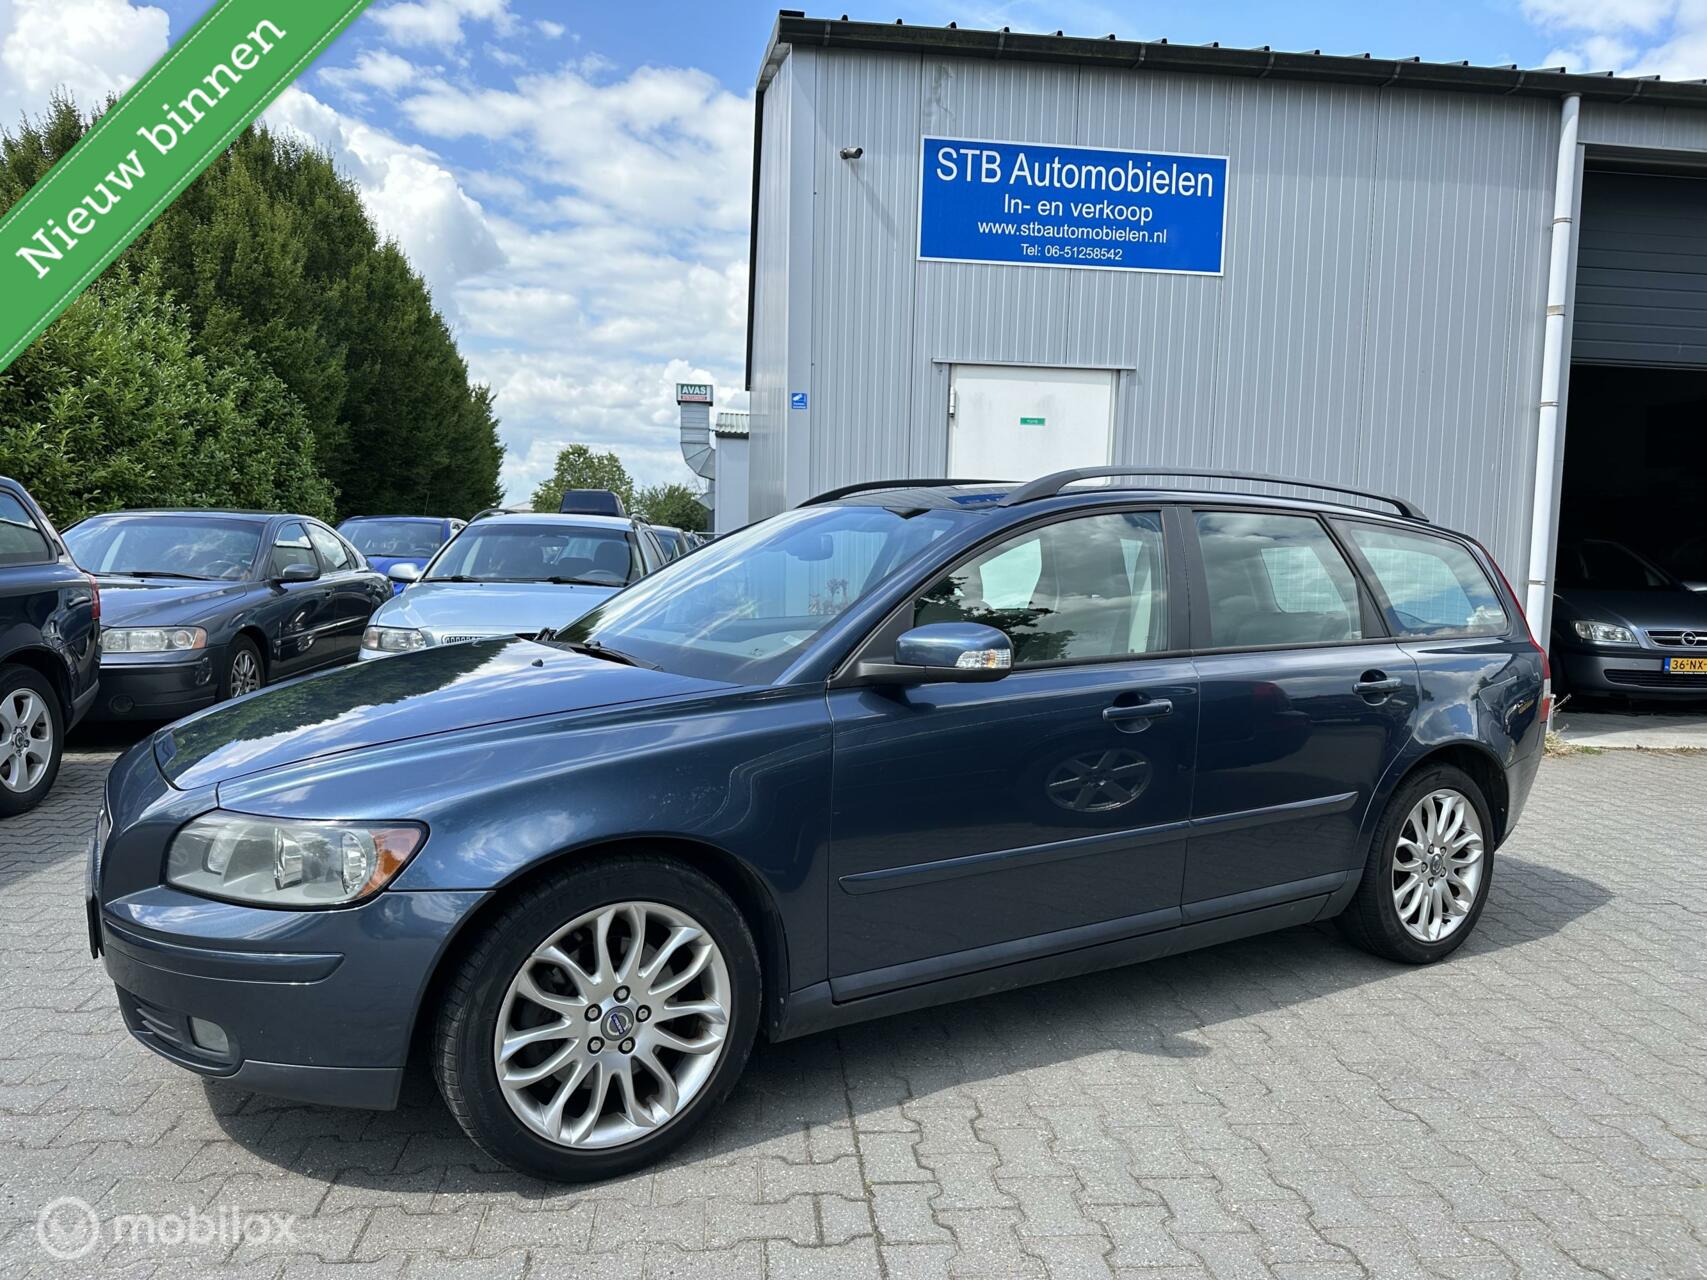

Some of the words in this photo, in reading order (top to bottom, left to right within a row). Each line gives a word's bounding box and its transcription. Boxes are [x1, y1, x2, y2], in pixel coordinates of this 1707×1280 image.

[936, 147, 1001, 183] STB
[1009, 153, 1213, 197] Automobielen
[1004, 194, 1031, 214] In-
[1037, 199, 1063, 216] en
[1070, 200, 1153, 225] verkoop
[978, 221, 1167, 243] www.stbautomobielen.nl
[1021, 244, 1041, 256] Tel:
[1045, 246, 1122, 260] 06-51258542
[682, 385, 706, 394] AVAS
